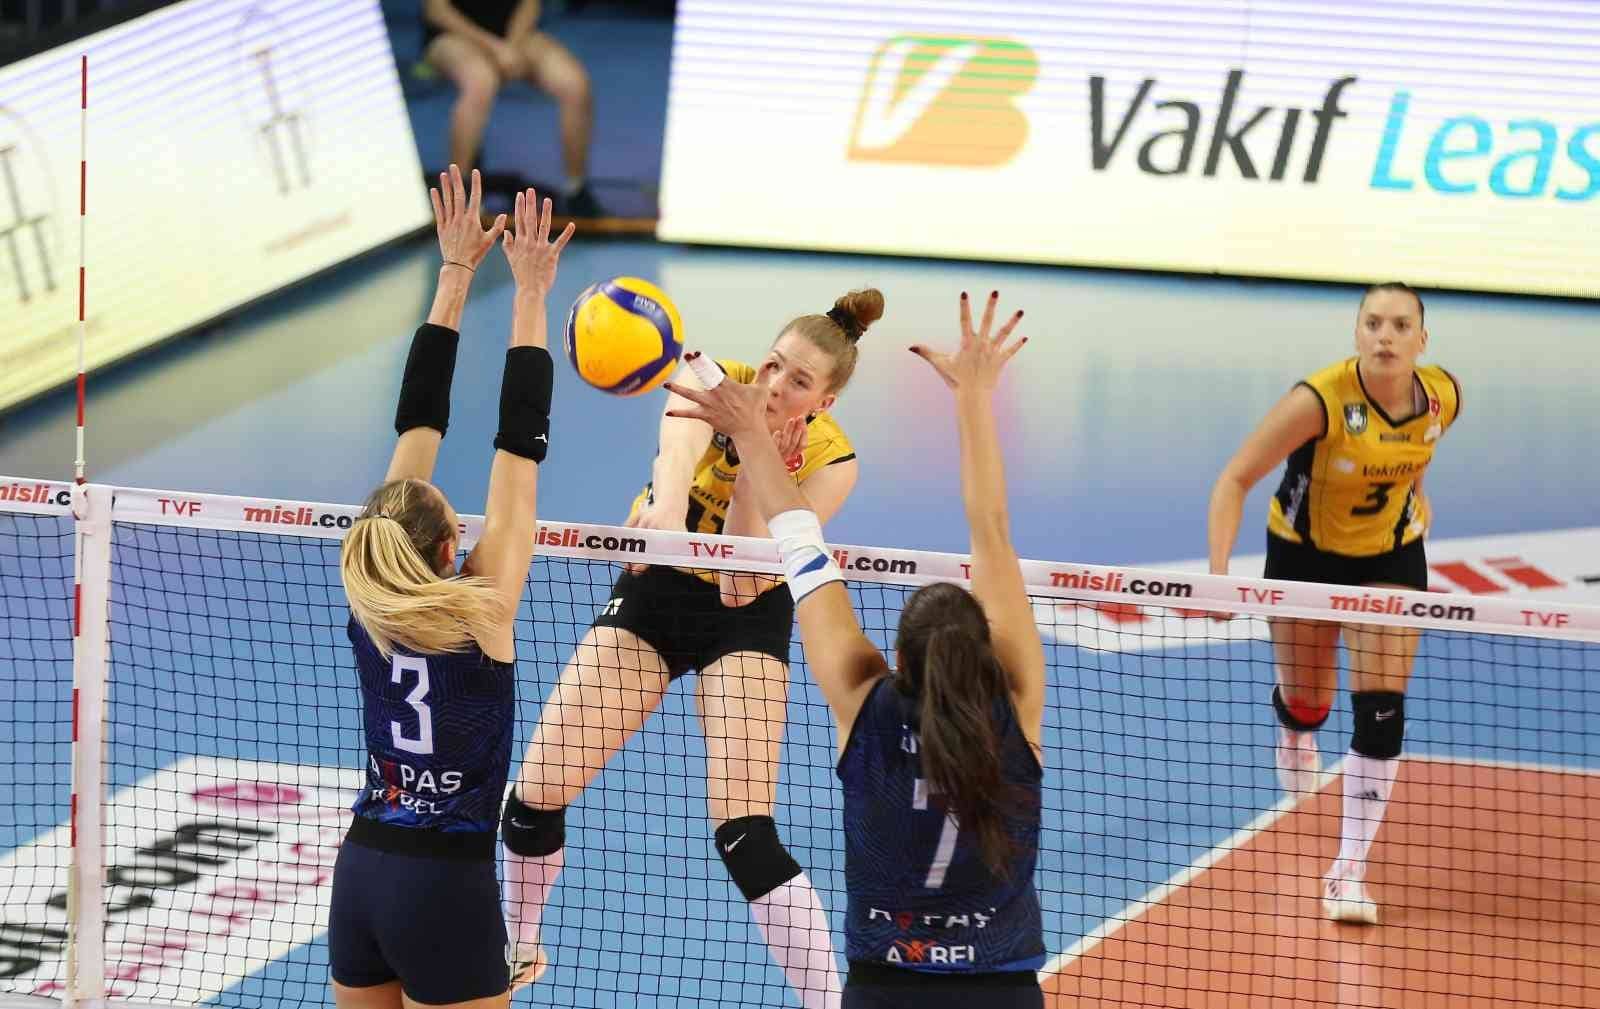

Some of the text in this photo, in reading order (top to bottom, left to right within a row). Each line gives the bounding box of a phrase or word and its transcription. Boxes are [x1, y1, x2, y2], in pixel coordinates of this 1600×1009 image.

[1089, 68, 1357, 184] Vakıf
[0, 482, 70, 506] isli.c
[1351, 482, 1394, 516] 3
[158, 498, 352, 529] TVF misli.co
[689, 541, 735, 560] TVF
[1050, 570, 1569, 628] misli.com TVF misli.com TVF
[391, 654, 434, 754] 3
